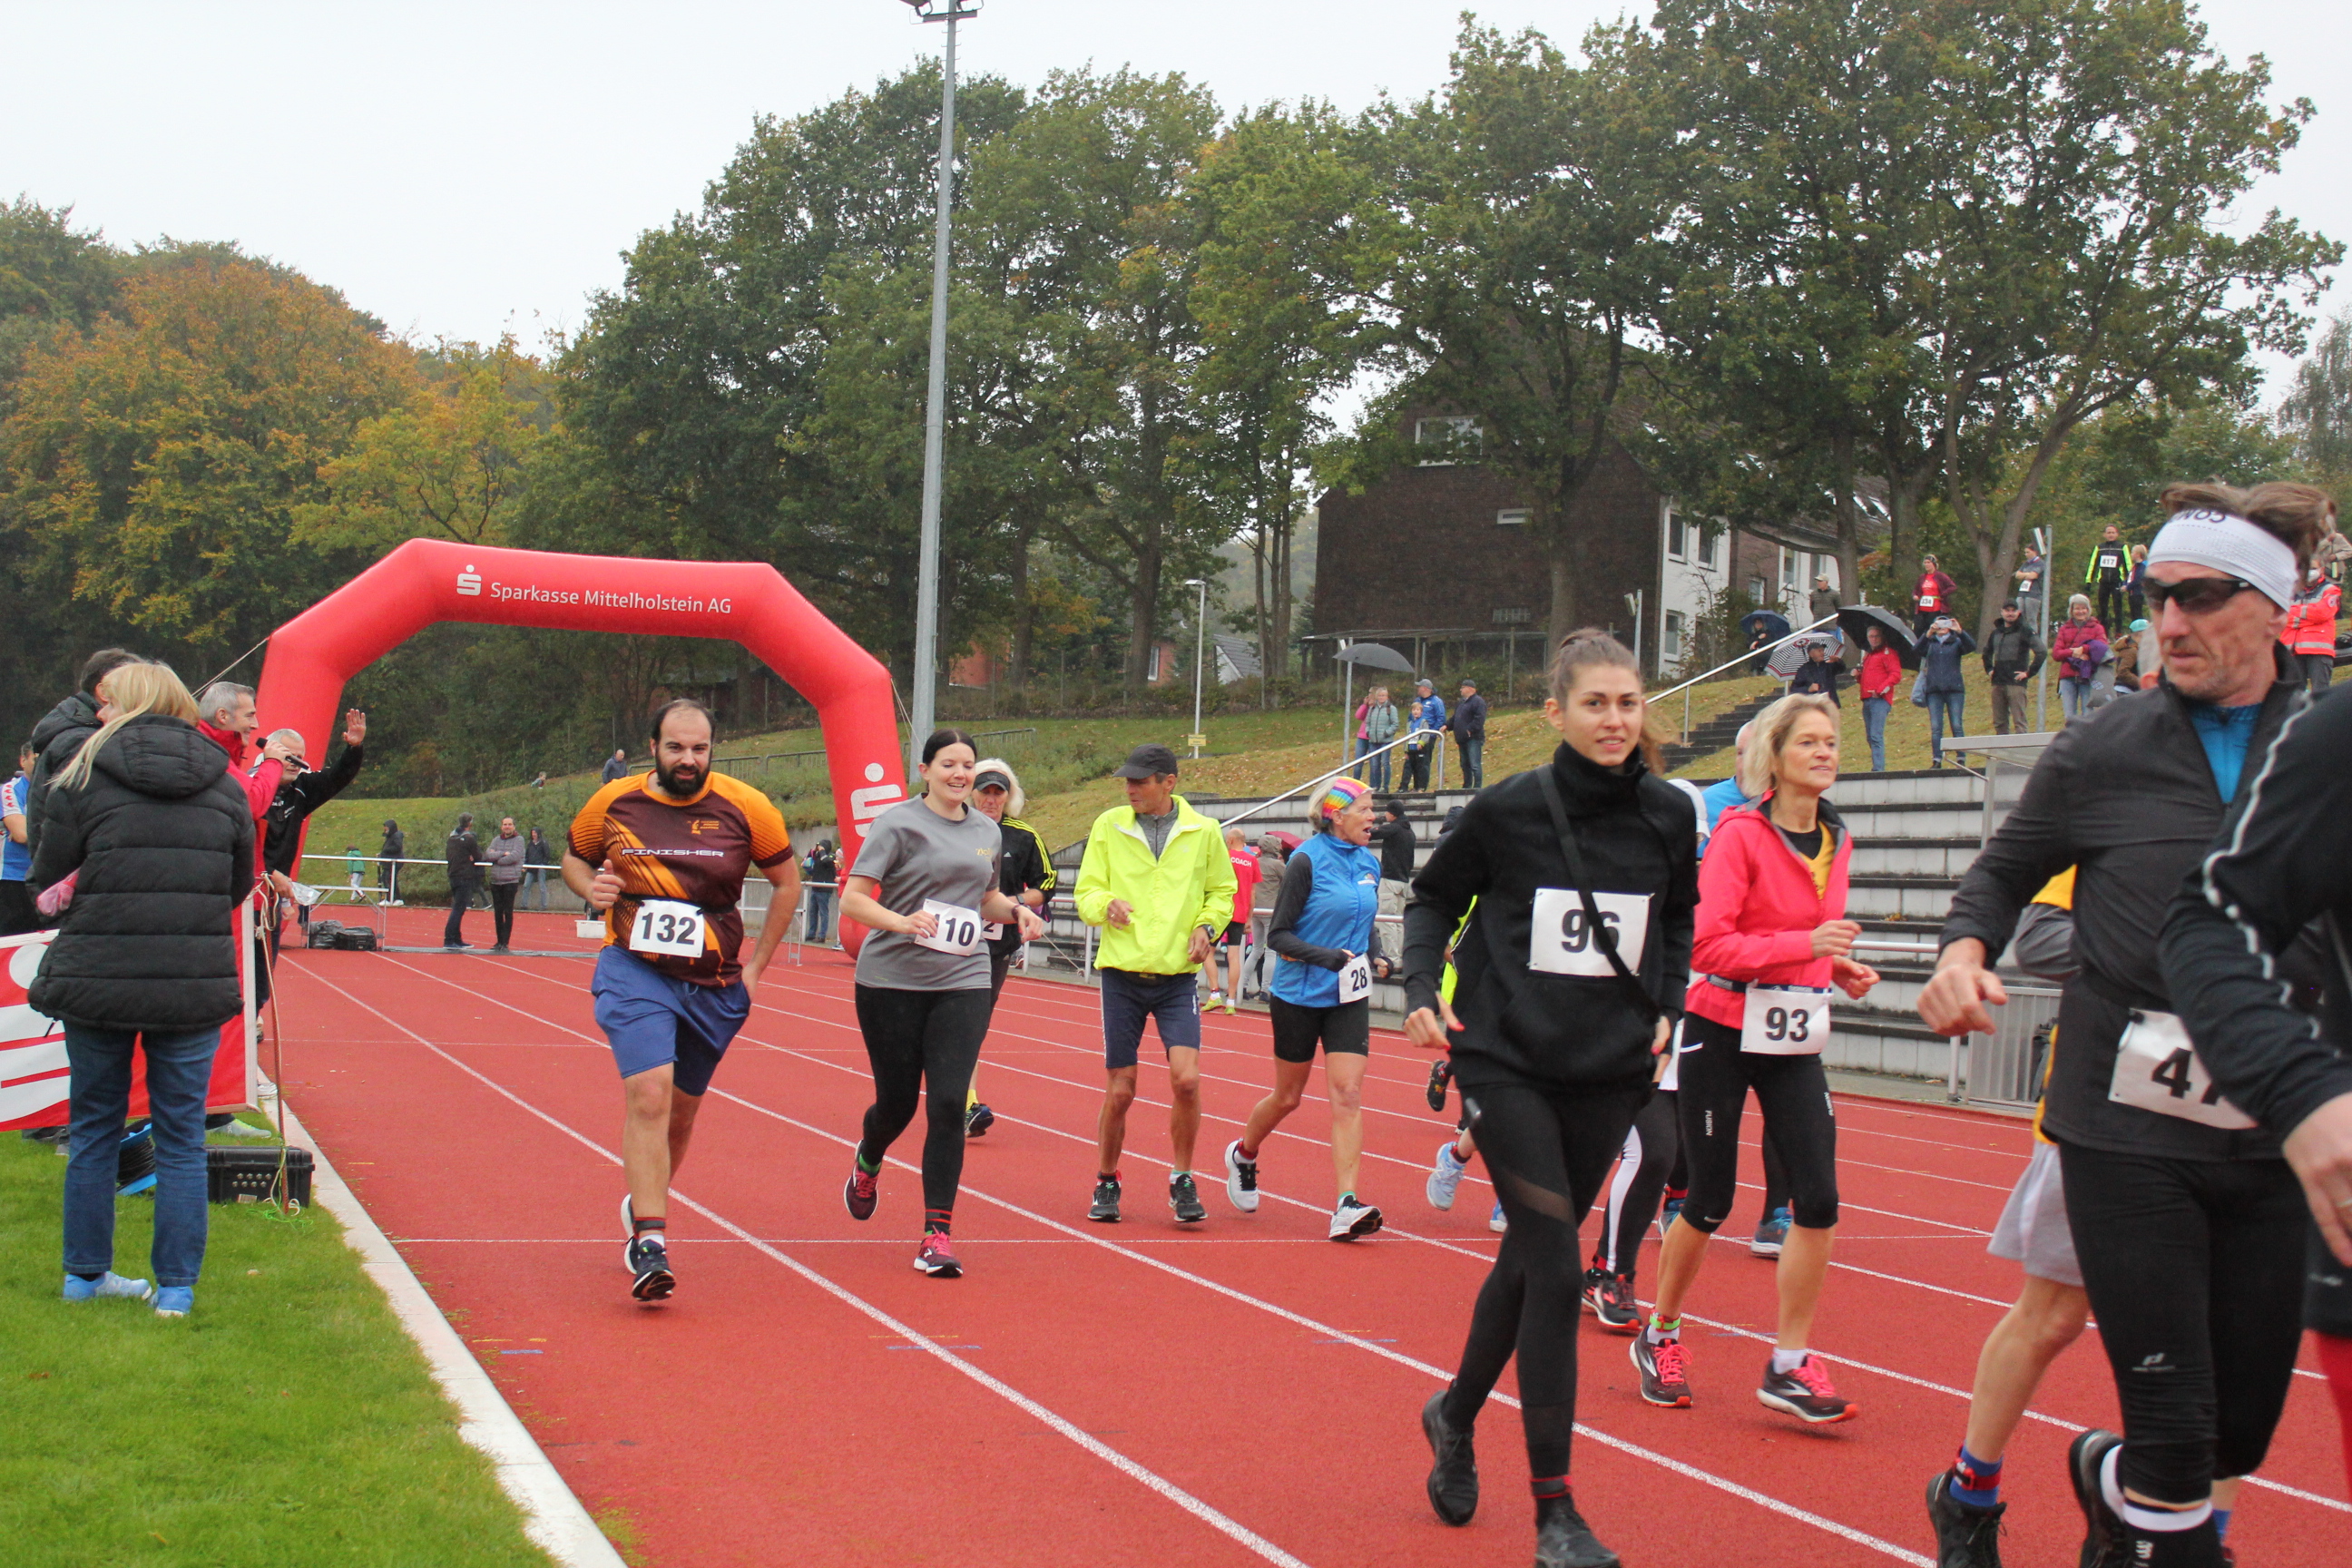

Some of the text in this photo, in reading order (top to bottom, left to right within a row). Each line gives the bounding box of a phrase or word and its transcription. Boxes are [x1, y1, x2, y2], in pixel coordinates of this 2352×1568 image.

[490, 582, 731, 613] Sparkasse Mittelholstein AG
[622, 848, 724, 858] FINISHER
[1230, 857, 1252, 867] COACH
[641, 911, 697, 946] 132
[1561, 908, 1621, 956] 96
[1350, 965, 1367, 992] 28
[1765, 1006, 1808, 1043] 93
[2151, 1047, 2220, 1106] 4
[1705, 1110, 1713, 1136] FUSION
